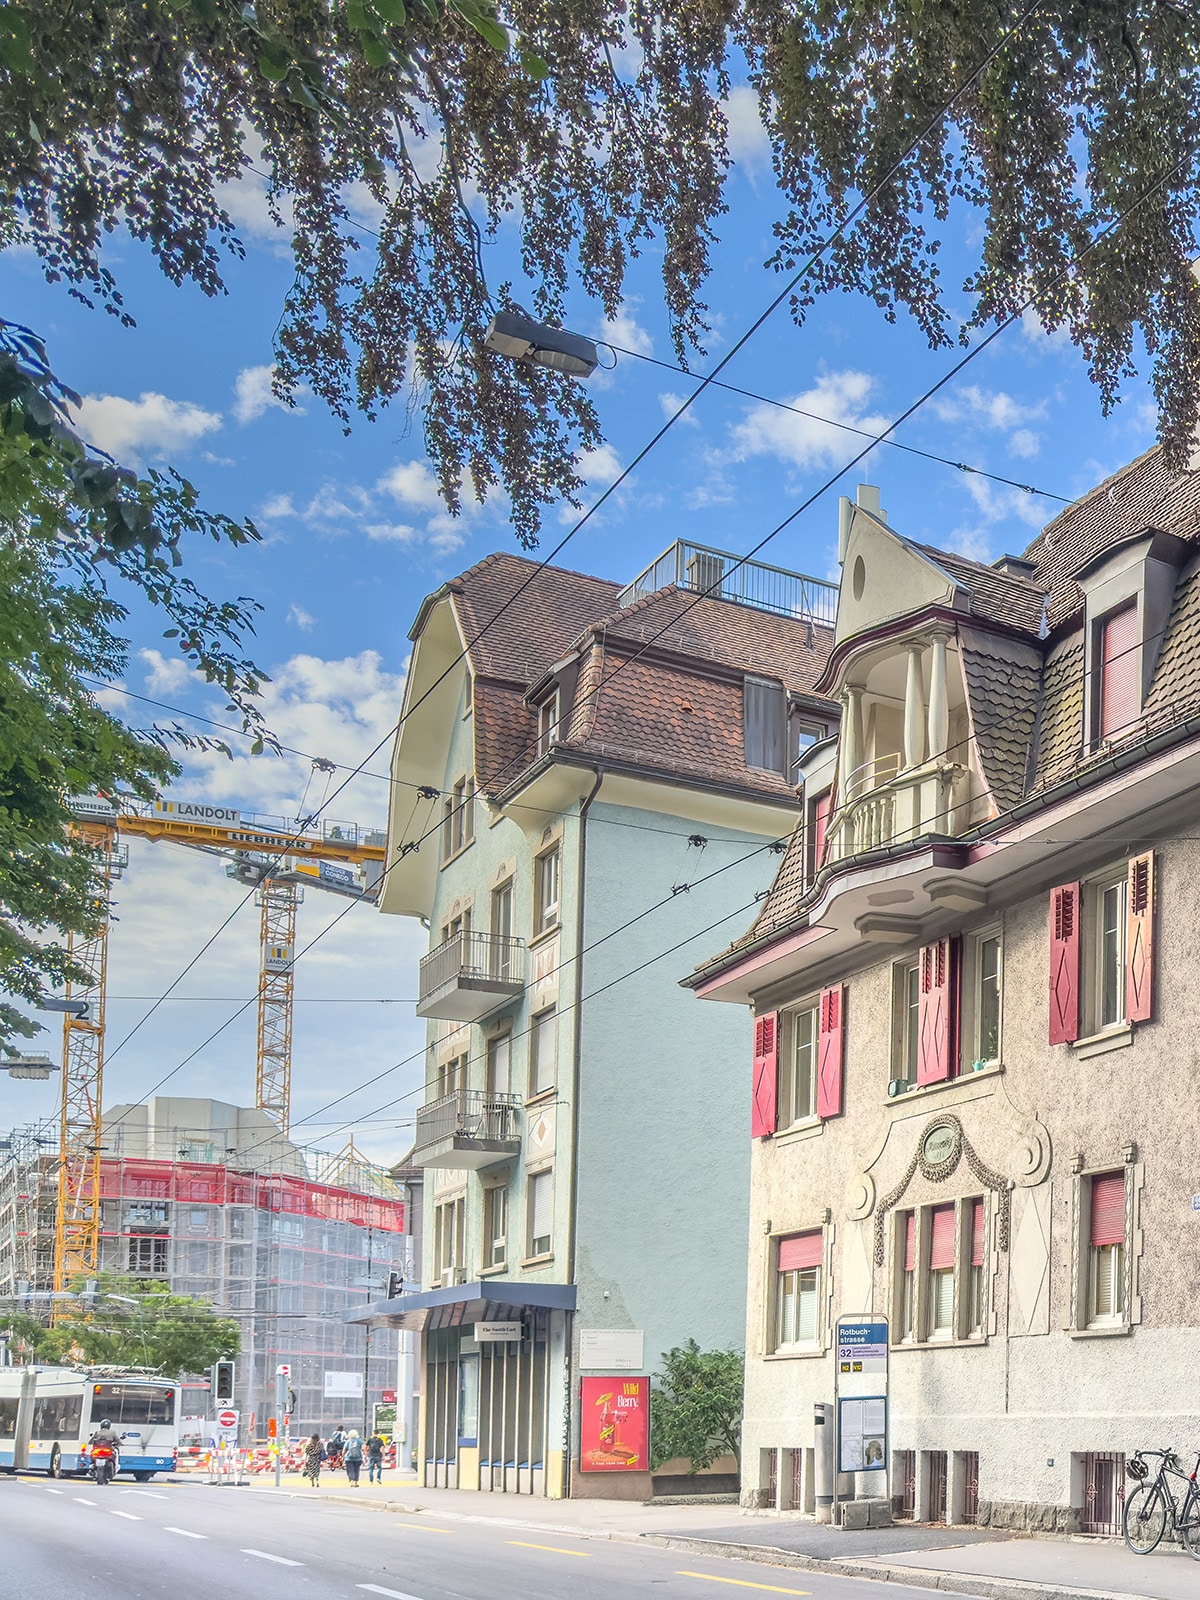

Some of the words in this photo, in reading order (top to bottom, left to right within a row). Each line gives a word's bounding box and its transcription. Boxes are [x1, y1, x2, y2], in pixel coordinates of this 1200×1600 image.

[178, 803, 238, 821] LANDOLT
[232, 833, 307, 849] LIEBHERR
[75, 1001, 90, 1020] 2
[840, 1328, 871, 1336] Rotbuch-
[840, 1349, 852, 1358] 32
[623, 1383, 639, 1394] Wild
